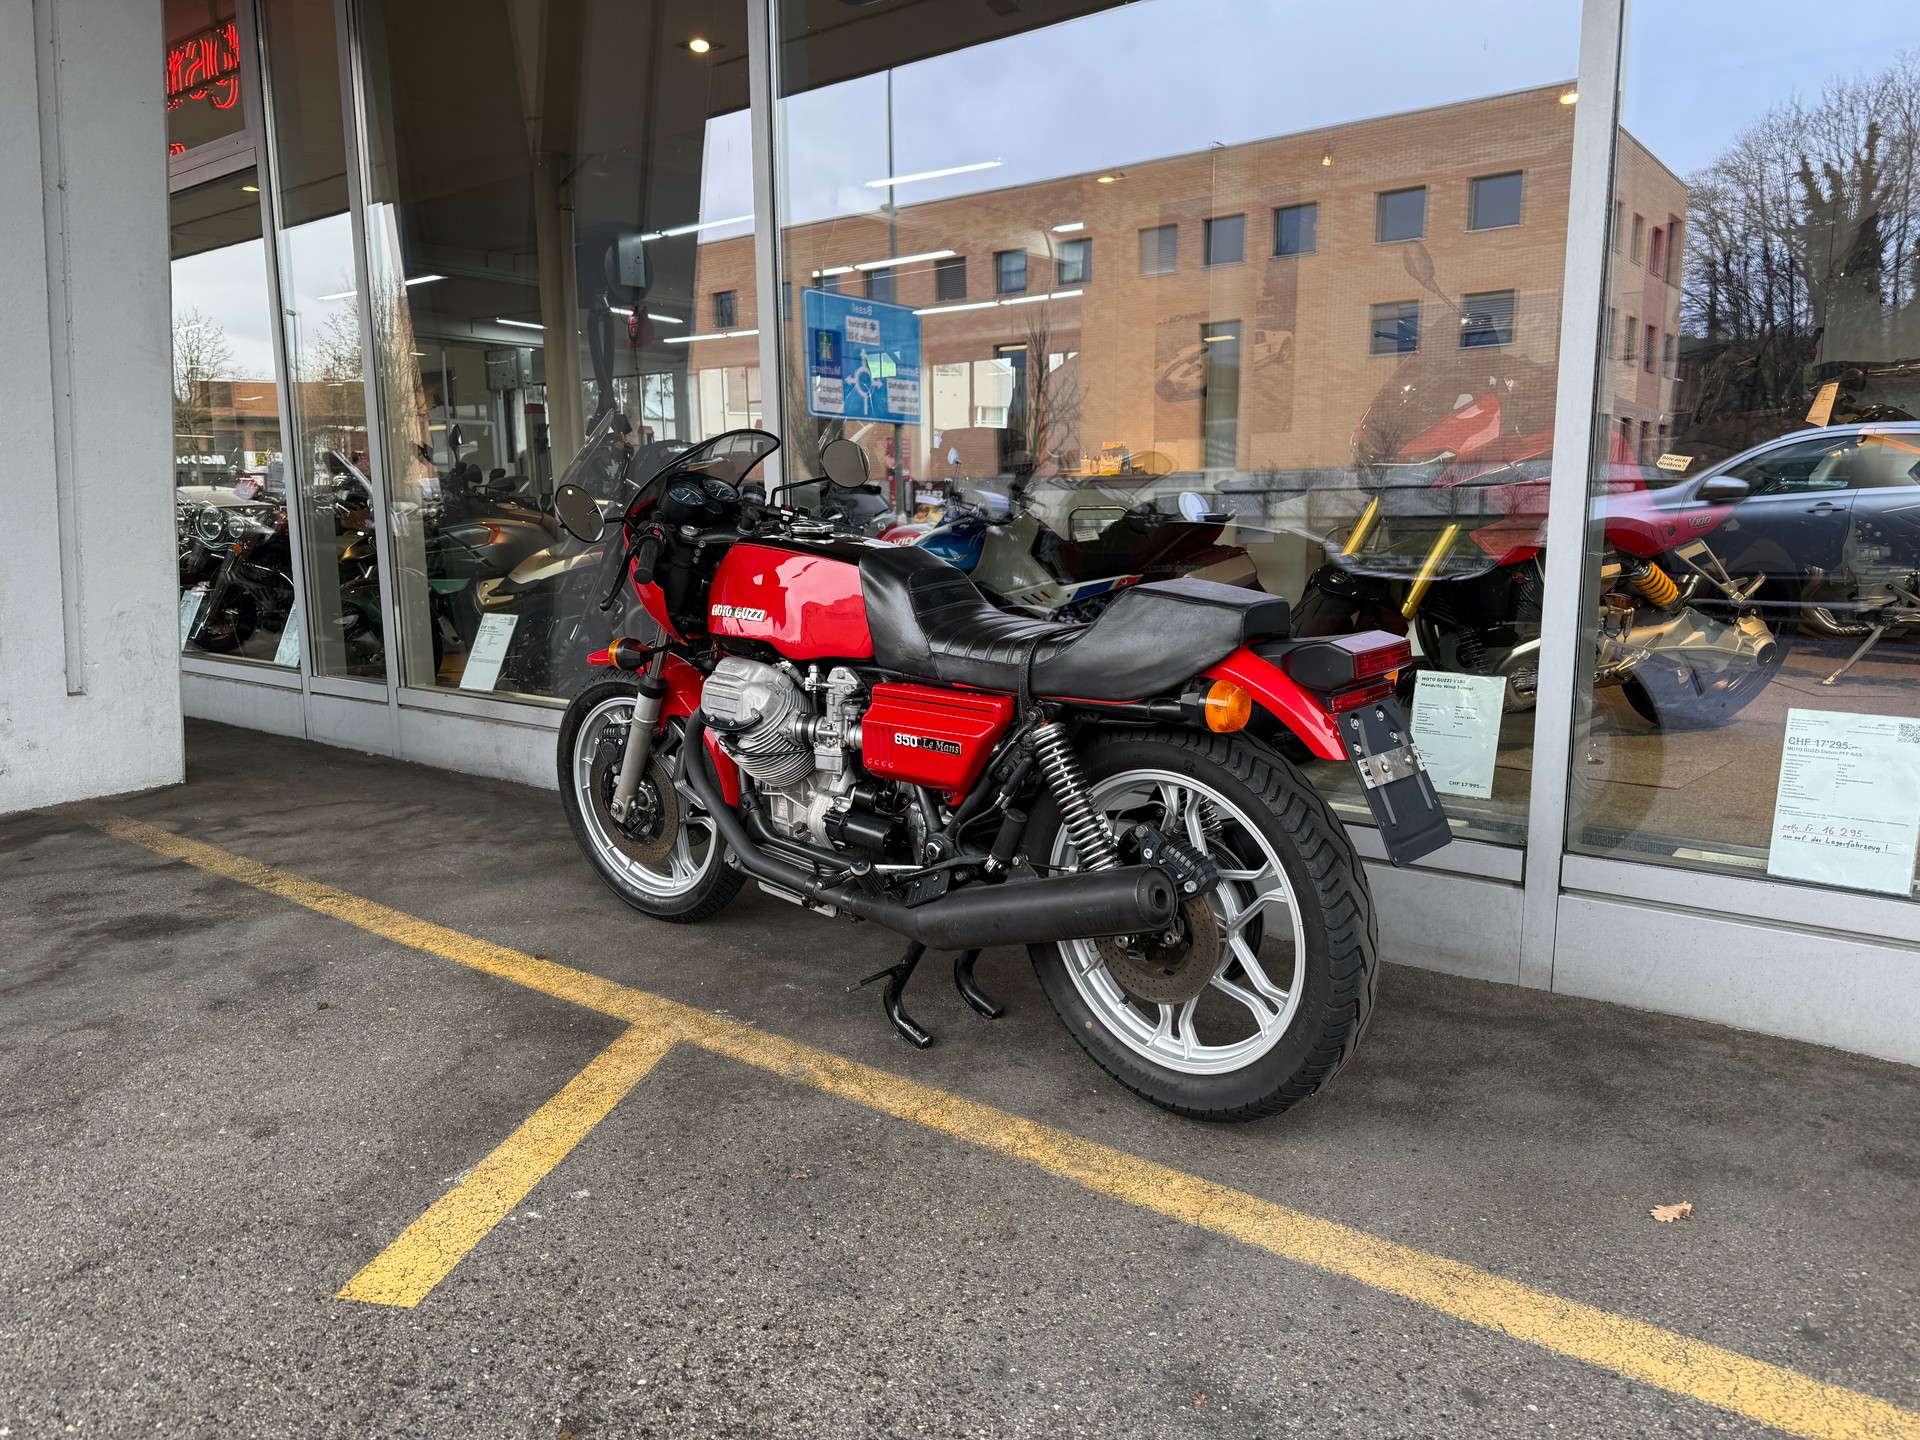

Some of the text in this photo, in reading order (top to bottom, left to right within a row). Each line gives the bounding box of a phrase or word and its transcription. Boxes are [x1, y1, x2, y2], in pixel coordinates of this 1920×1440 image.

[734, 607, 766, 622] GUZZI
[894, 733, 960, 754] 850 Le Mans
[1788, 736, 1811, 746] CHF
[1822, 826, 1835, 835] 16
